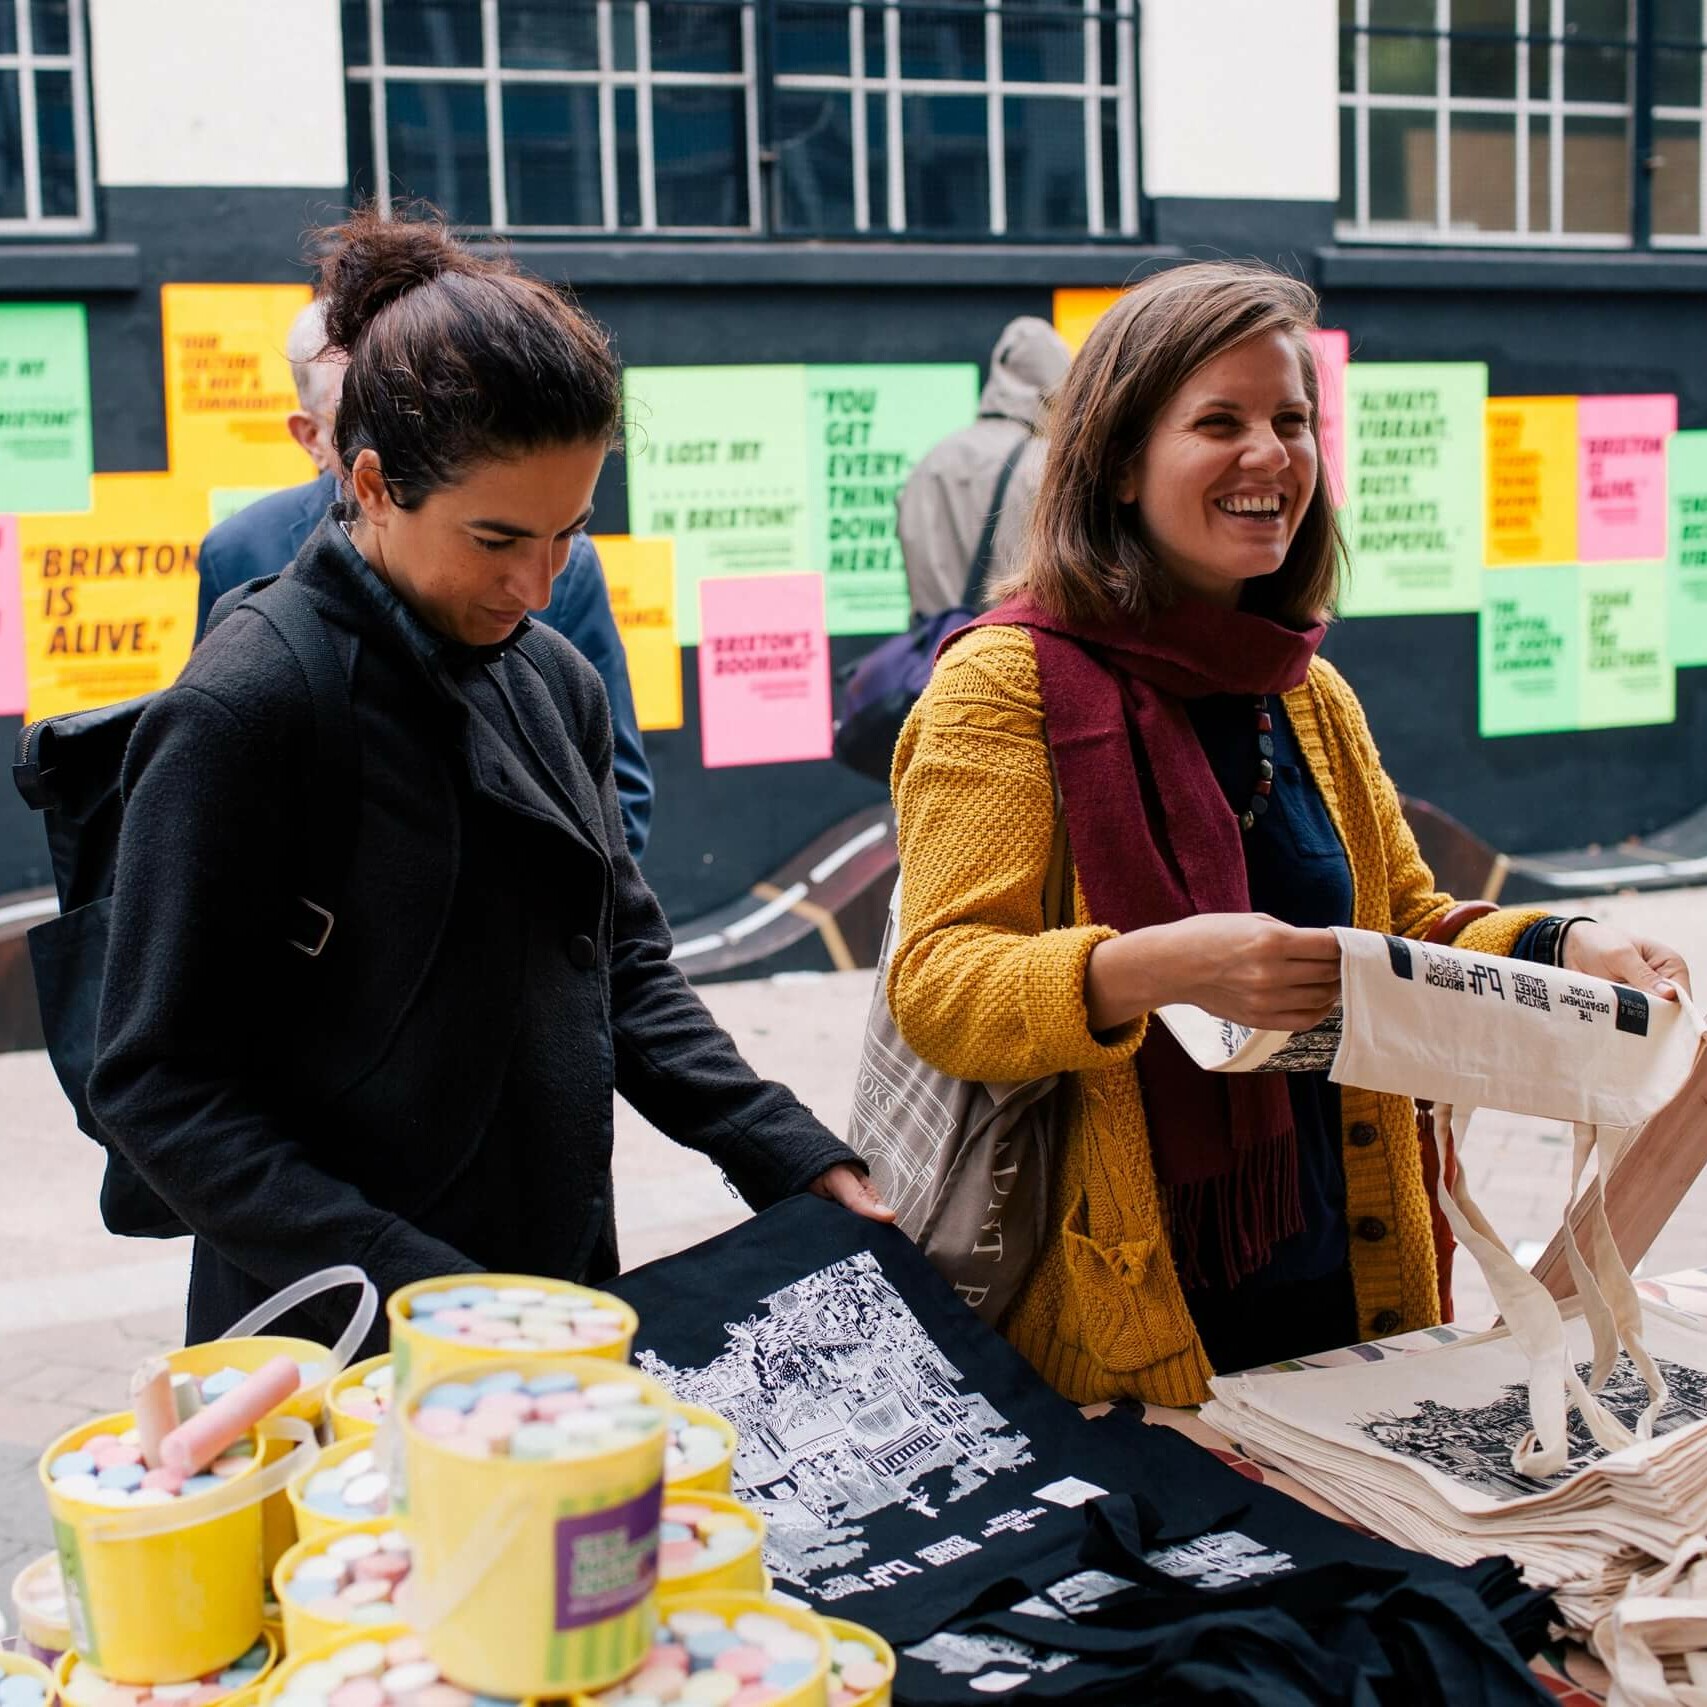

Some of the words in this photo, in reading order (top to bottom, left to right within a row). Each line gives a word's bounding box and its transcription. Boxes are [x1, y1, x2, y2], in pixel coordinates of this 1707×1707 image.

[825, 420, 870, 446] GET
[665, 439, 718, 465] LOST
[728, 438, 764, 462] MY
[45, 586, 74, 617] IS
[1429, 962, 1464, 980] DESIGN
[1510, 971, 1547, 988] GALLERY
[1425, 973, 1465, 992] BRIXTON
[1514, 980, 1549, 1001] STREET
[1567, 985, 1595, 999] STORE
[1515, 994, 1551, 1012] BRIXTON
[1559, 993, 1610, 1014] DEPARTMENT
[1578, 1009, 1593, 1023] THE
[858, 1064, 896, 1115] OKS
